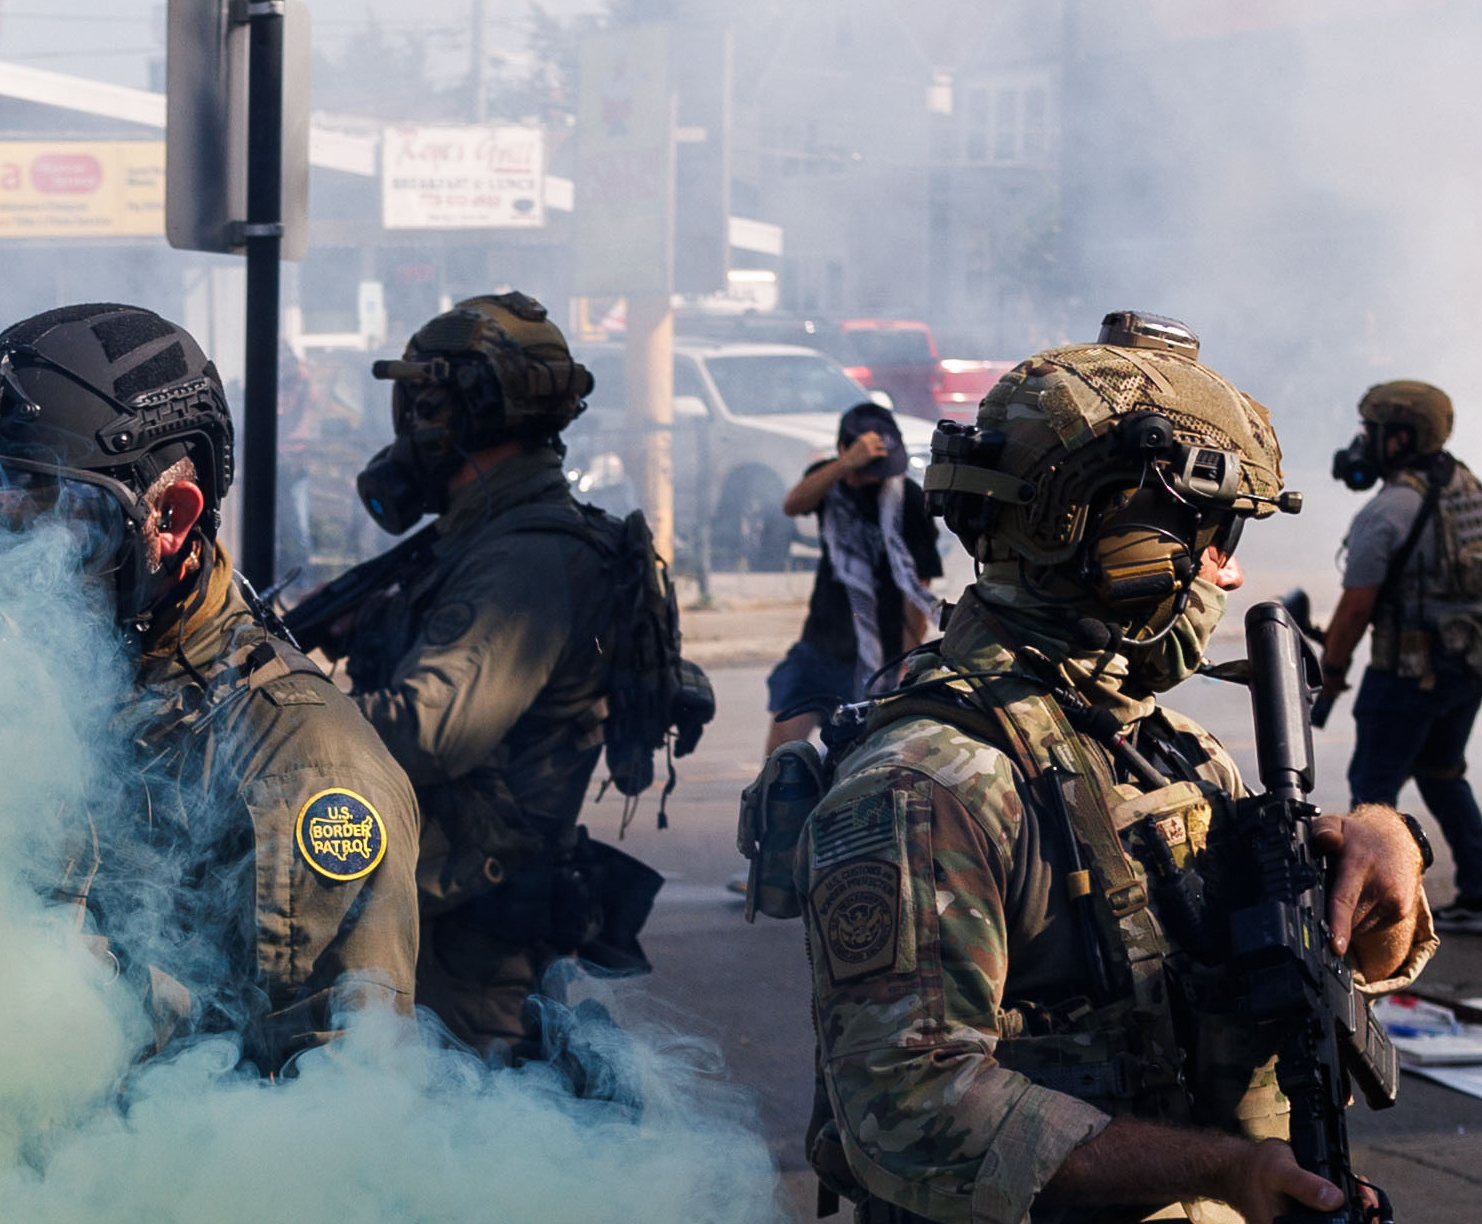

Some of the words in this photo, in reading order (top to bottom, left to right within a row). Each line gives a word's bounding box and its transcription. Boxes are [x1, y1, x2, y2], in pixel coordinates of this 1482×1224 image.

[327, 806, 354, 820] U.S.
[313, 824, 372, 839] BORDER
[314, 839, 372, 855] PATROL
